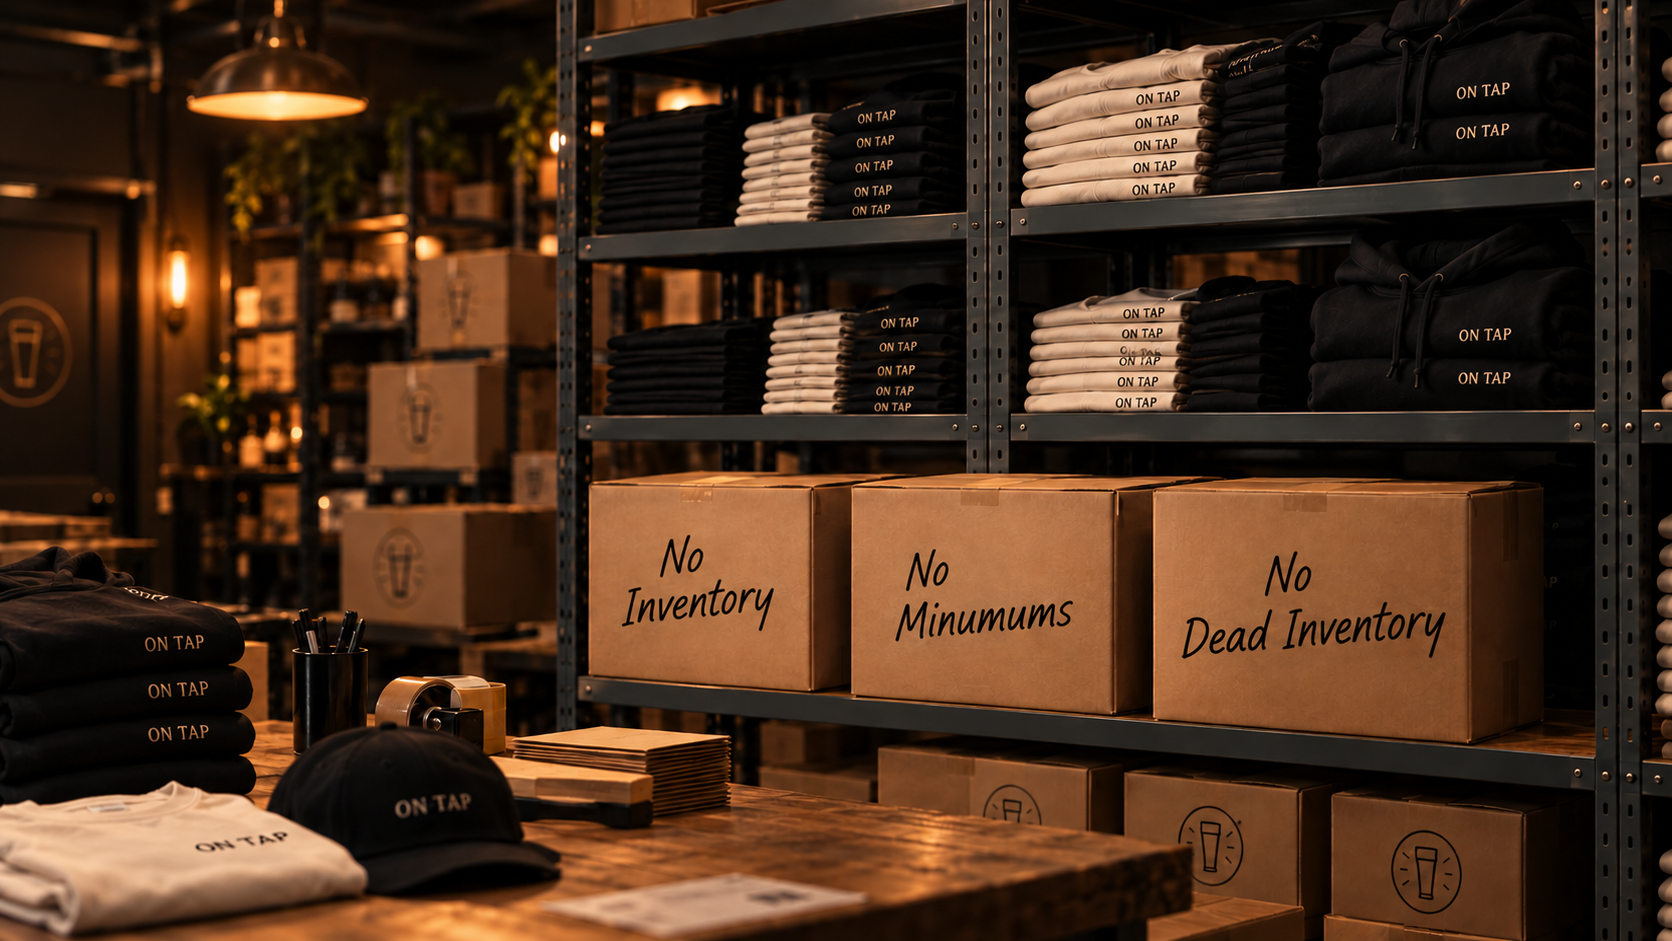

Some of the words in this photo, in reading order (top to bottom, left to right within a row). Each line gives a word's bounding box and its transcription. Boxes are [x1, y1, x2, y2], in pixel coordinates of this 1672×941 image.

[1135, 93, 1154, 105] ON
[1157, 89, 1181, 103] TAP
[1456, 85, 1478, 99] ON
[1481, 81, 1511, 96] TAP
[857, 112, 873, 124] ON
[874, 109, 897, 121] TAP
[1135, 117, 1153, 129] ON
[1156, 114, 1180, 127] TAP
[1455, 125, 1477, 139] ON
[1481, 122, 1510, 137] TAP
[856, 137, 872, 148] ON
[874, 134, 895, 146] TAP
[1133, 140, 1152, 151] ON
[1155, 137, 1178, 150] TAP
[854, 161, 871, 173] ON
[873, 159, 894, 171] TAP
[1132, 161, 1150, 173] ON
[1154, 159, 1177, 172] TAP
[853, 186, 870, 197] ON
[871, 184, 893, 195] TAP
[1131, 184, 1149, 196] ON
[1153, 182, 1176, 194] TAP
[852, 205, 868, 216] ON
[870, 203, 891, 214] TAP
[1122, 308, 1140, 319] ON
[1143, 306, 1165, 318] TAP
[880, 317, 897, 328] ON
[898, 316, 920, 327] TAP
[1121, 328, 1138, 339] ON
[1141, 327, 1164, 338] TAP
[1458, 328, 1480, 341] ON
[1483, 327, 1512, 341] TAP
[879, 342, 895, 352] ON
[897, 341, 918, 351] TAP
[877, 365, 893, 376] ON
[895, 364, 916, 375] TAP
[1117, 376, 1134, 387] ON
[1137, 376, 1159, 387] TAP
[1457, 371, 1479, 384] ON
[1483, 371, 1512, 384] TAP
[875, 386, 891, 396] ON
[894, 385, 915, 395] TAP
[873, 402, 889, 412] ON
[891, 401, 912, 411] TAP
[1115, 397, 1132, 408] ON
[1135, 396, 1158, 408] TAP
[660, 535, 703, 577] No
[906, 549, 949, 591] No
[1265, 551, 1311, 596] No
[622, 579, 774, 631] Inventory
[896, 601, 1073, 641] Minumums
[1182, 609, 1272, 659] Dead
[1282, 602, 1446, 658] Inventory
[144, 636, 168, 651] ON
[172, 634, 205, 649] TAP
[147, 683, 172, 698] ON
[176, 680, 209, 696] TAP
[147, 726, 173, 741] ON
[176, 724, 210, 739] TAP
[394, 796, 428, 819] ON
[432, 792, 472, 812] TAP
[194, 839, 236, 852] ON
[236, 831, 288, 846] TAP
